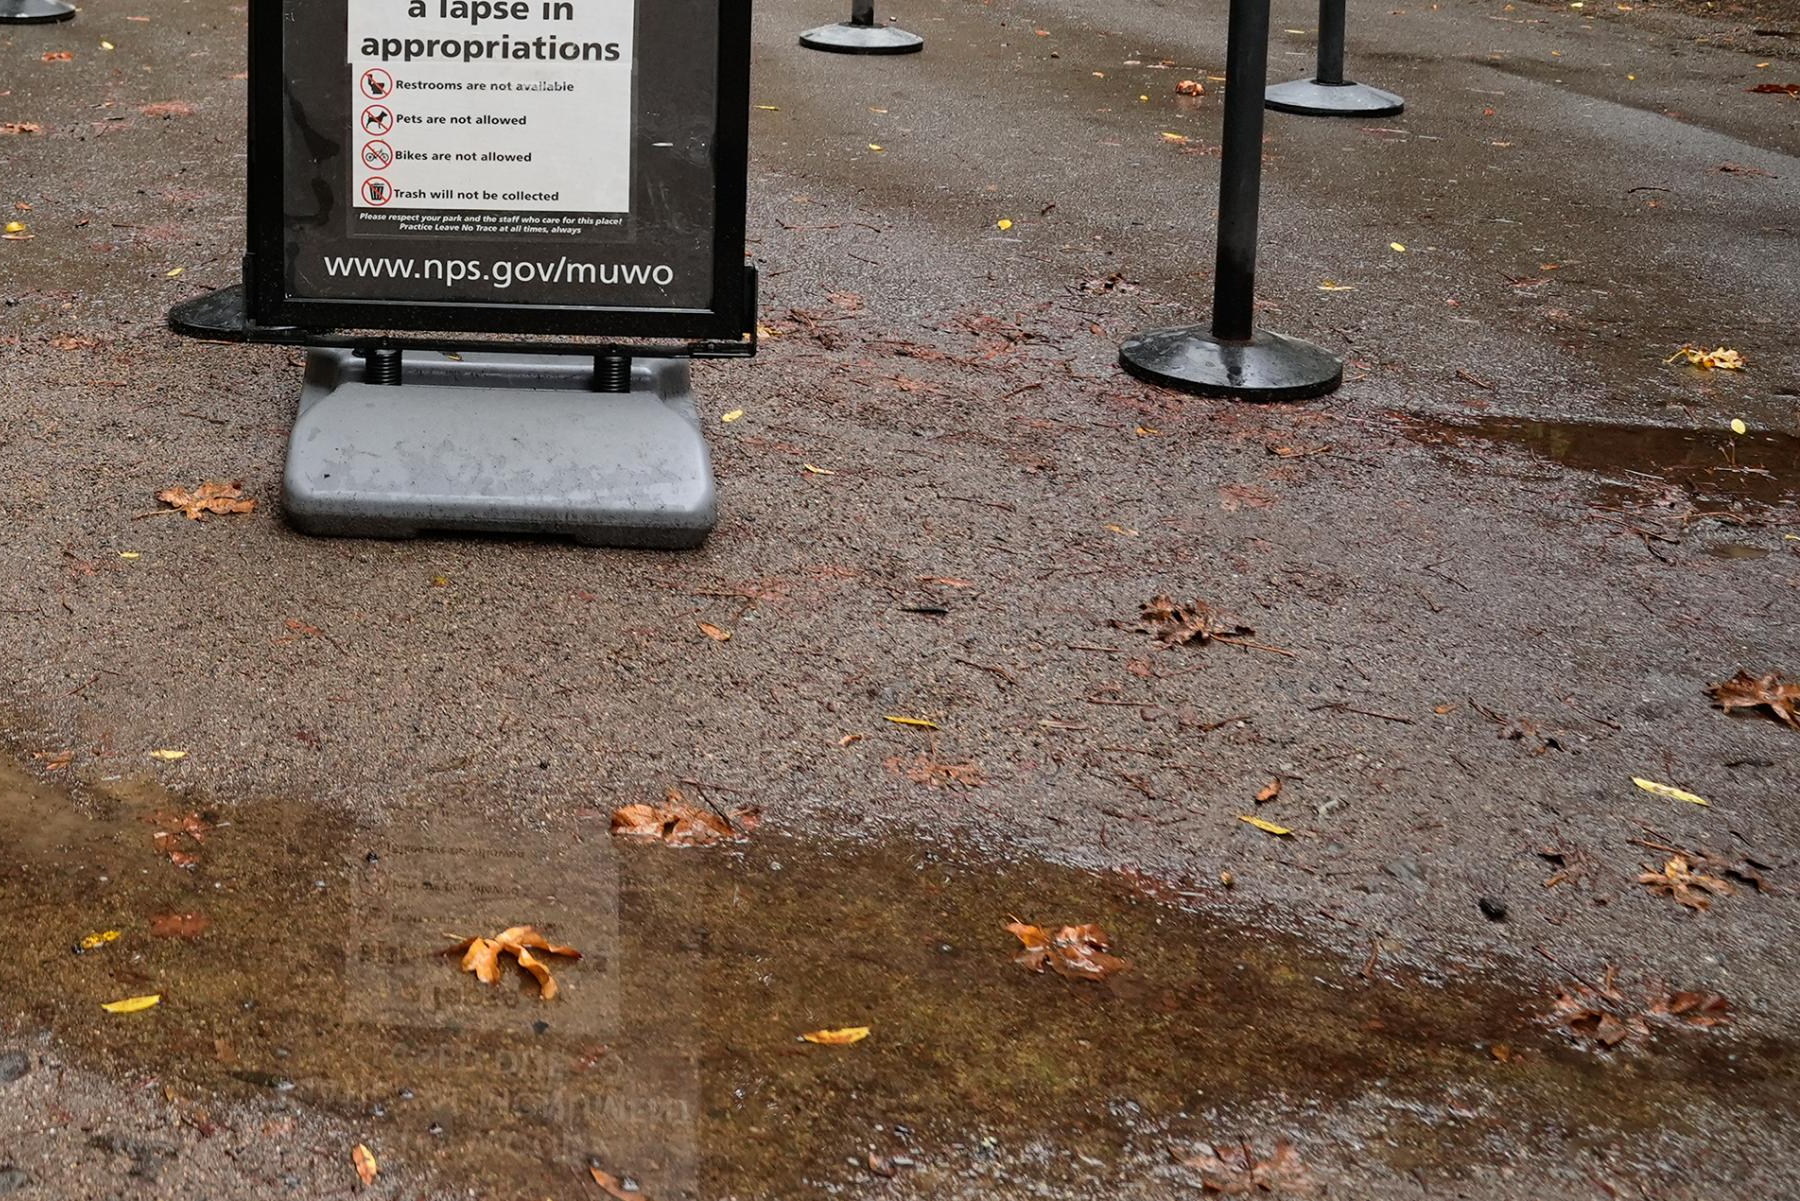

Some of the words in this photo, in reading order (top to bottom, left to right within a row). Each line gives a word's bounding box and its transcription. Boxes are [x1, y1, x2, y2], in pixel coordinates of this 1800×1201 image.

[407, 0, 427, 18] a
[360, 34, 621, 62] appropriations
[395, 80, 463, 91] Restrooms
[466, 82, 486, 91] are
[490, 81, 513, 92] not
[515, 81, 575, 92] available
[396, 114, 423, 125] Pets
[426, 116, 446, 125] are
[449, 115, 472, 125] not
[475, 114, 527, 126] allowed
[395, 150, 428, 161] Bikes
[431, 153, 452, 161] are
[455, 151, 477, 162] not
[480, 151, 532, 162] allowed
[394, 188, 426, 200] Trash
[430, 189, 453, 199] will
[457, 191, 479, 200] not
[482, 190, 498, 201] be
[502, 190, 560, 202] collected
[359, 212, 387, 221] Please
[388, 213, 420, 223] respect
[421, 215, 442, 223] your
[442, 214, 463, 224] park
[464, 214, 482, 222] and
[482, 214, 497, 223] the
[498, 214, 520, 224] staff
[521, 215, 541, 224] who
[562, 216, 576, 225] for
[576, 216, 594, 225] this
[595, 217, 623, 226] place!
[399, 223, 433, 231] Practice
[434, 223, 460, 232] Leave
[461, 224, 474, 232] No
[476, 224, 498, 232] Trace
[499, 224, 510, 233] at
[510, 224, 522, 233] all
[523, 224, 549, 234] times,
[551, 225, 582, 235] always
[324, 255, 674, 288] www.nps.gov/muwo
